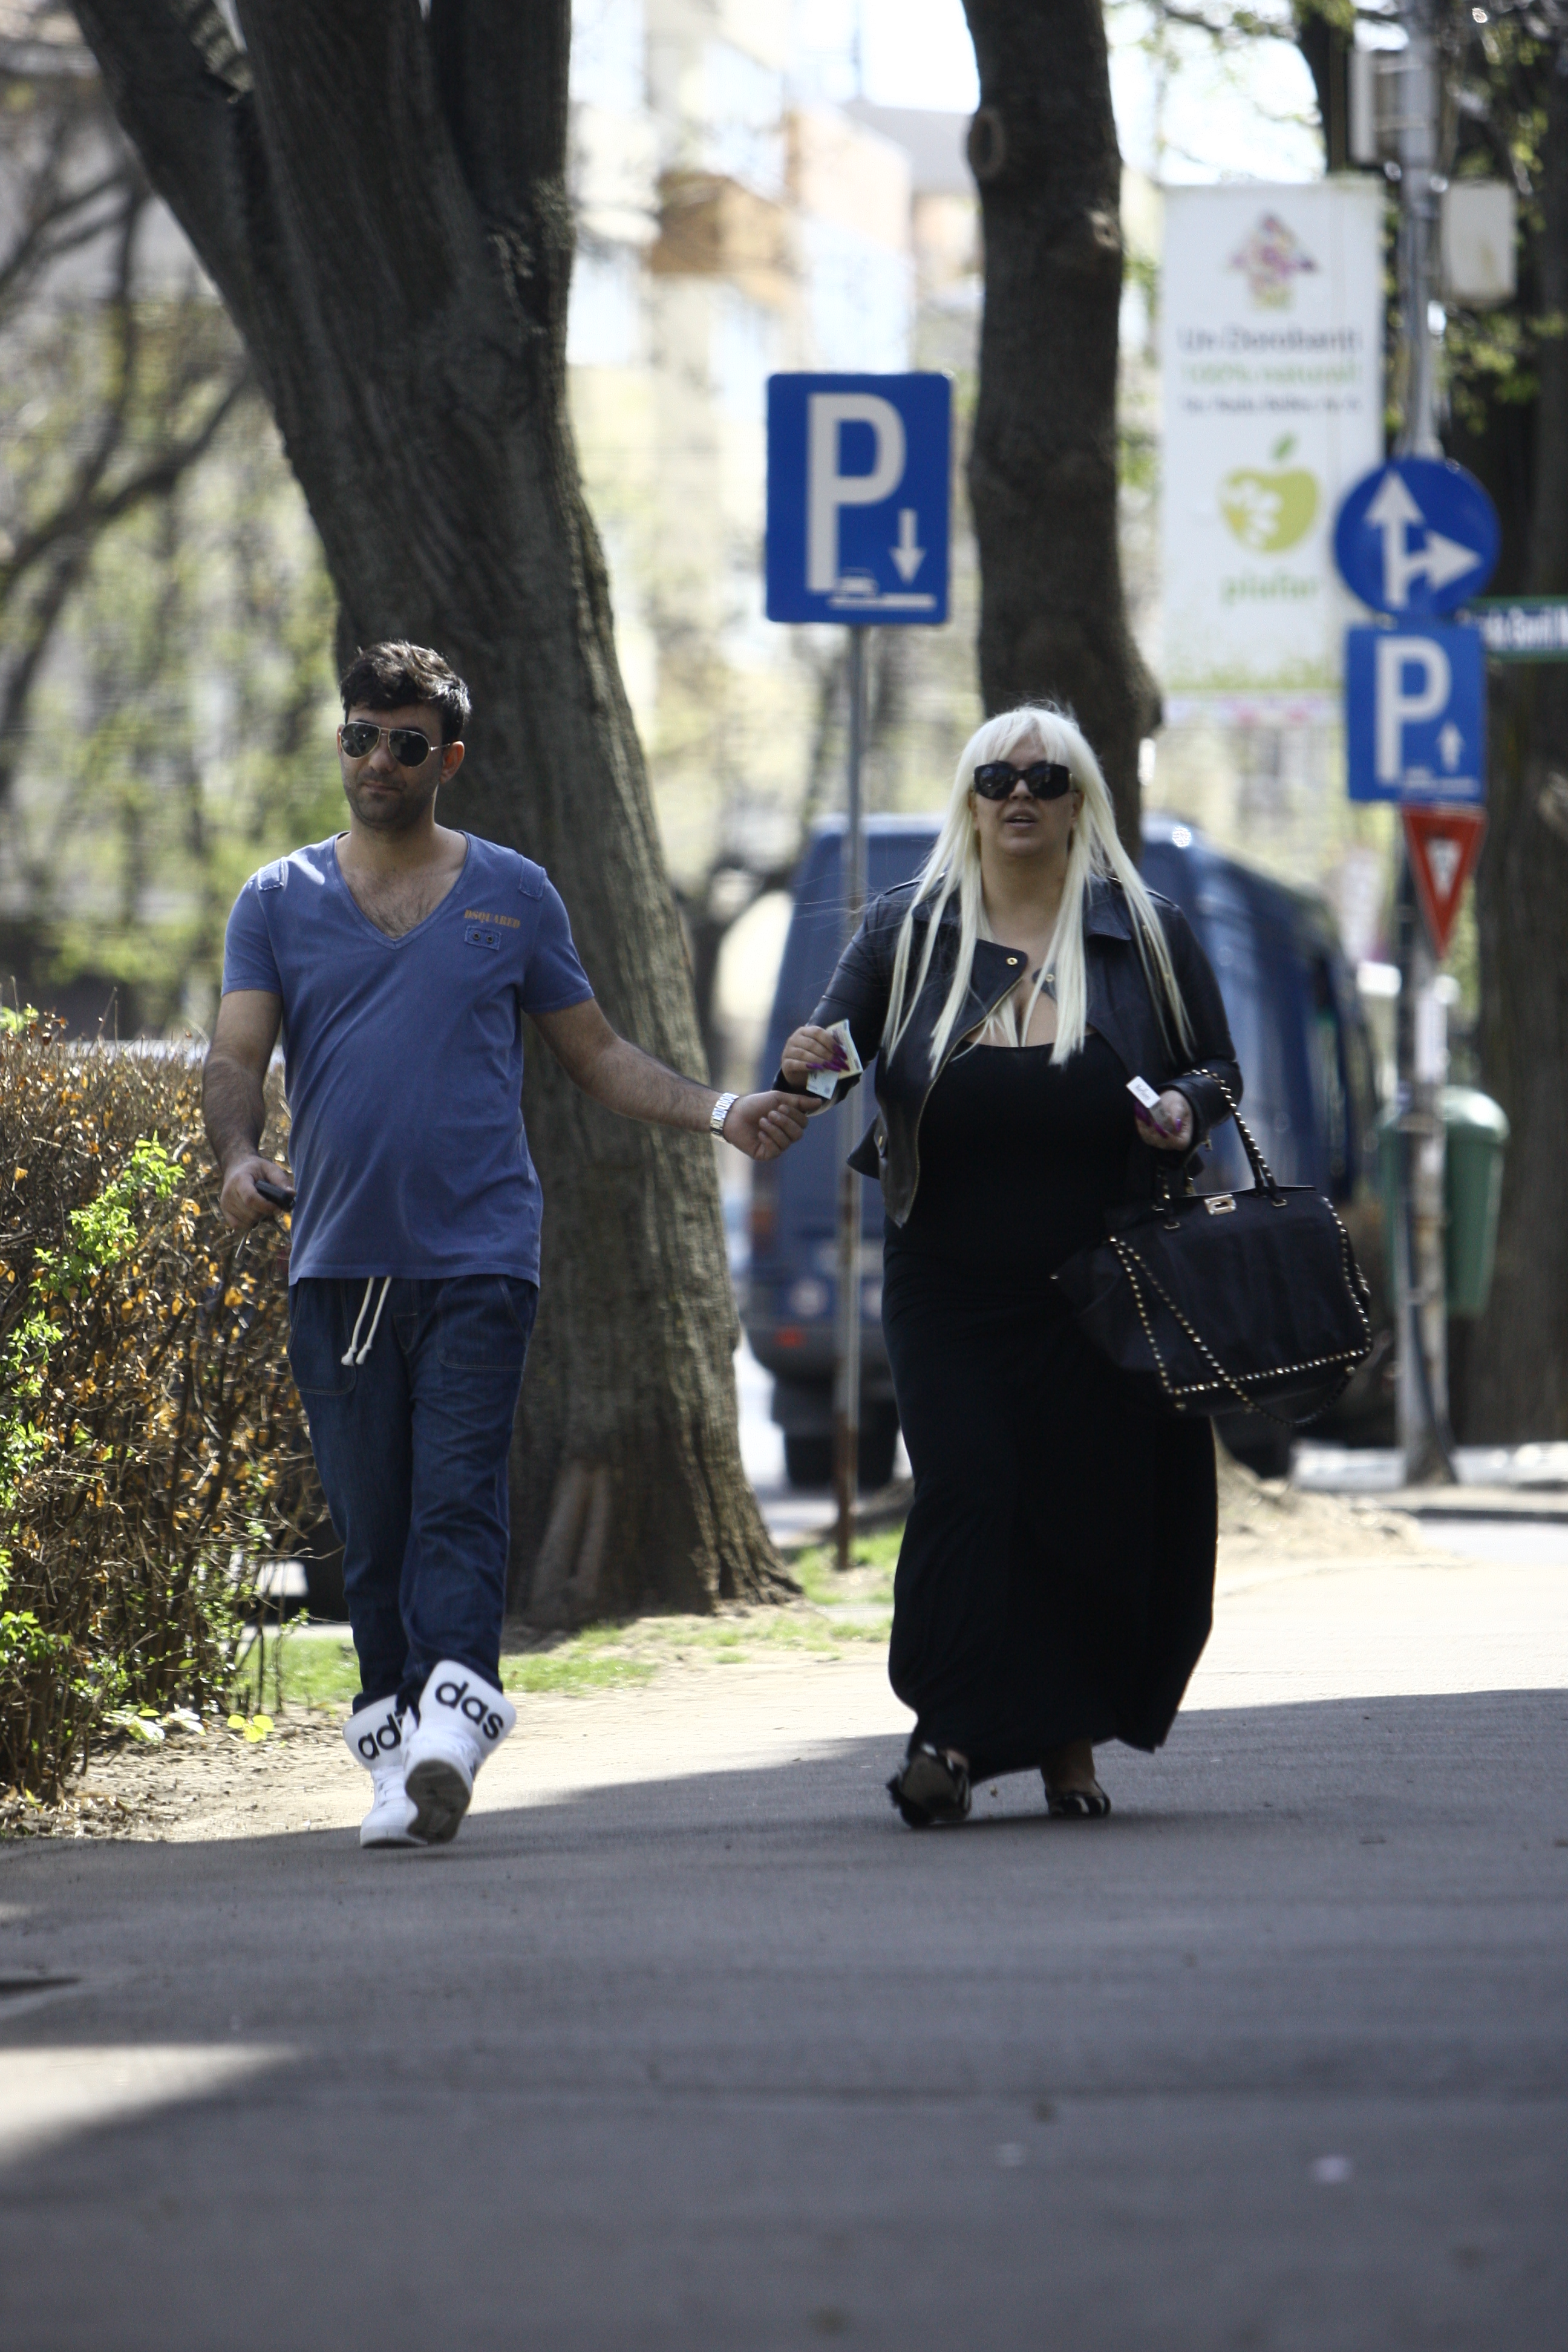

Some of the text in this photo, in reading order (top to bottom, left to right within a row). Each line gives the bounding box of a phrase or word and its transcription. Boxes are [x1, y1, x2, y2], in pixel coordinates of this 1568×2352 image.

[806, 393, 906, 592] P
[1376, 636, 1449, 786] P
[464, 909, 520, 929] DSQUARED
[436, 1681, 504, 1740] das
